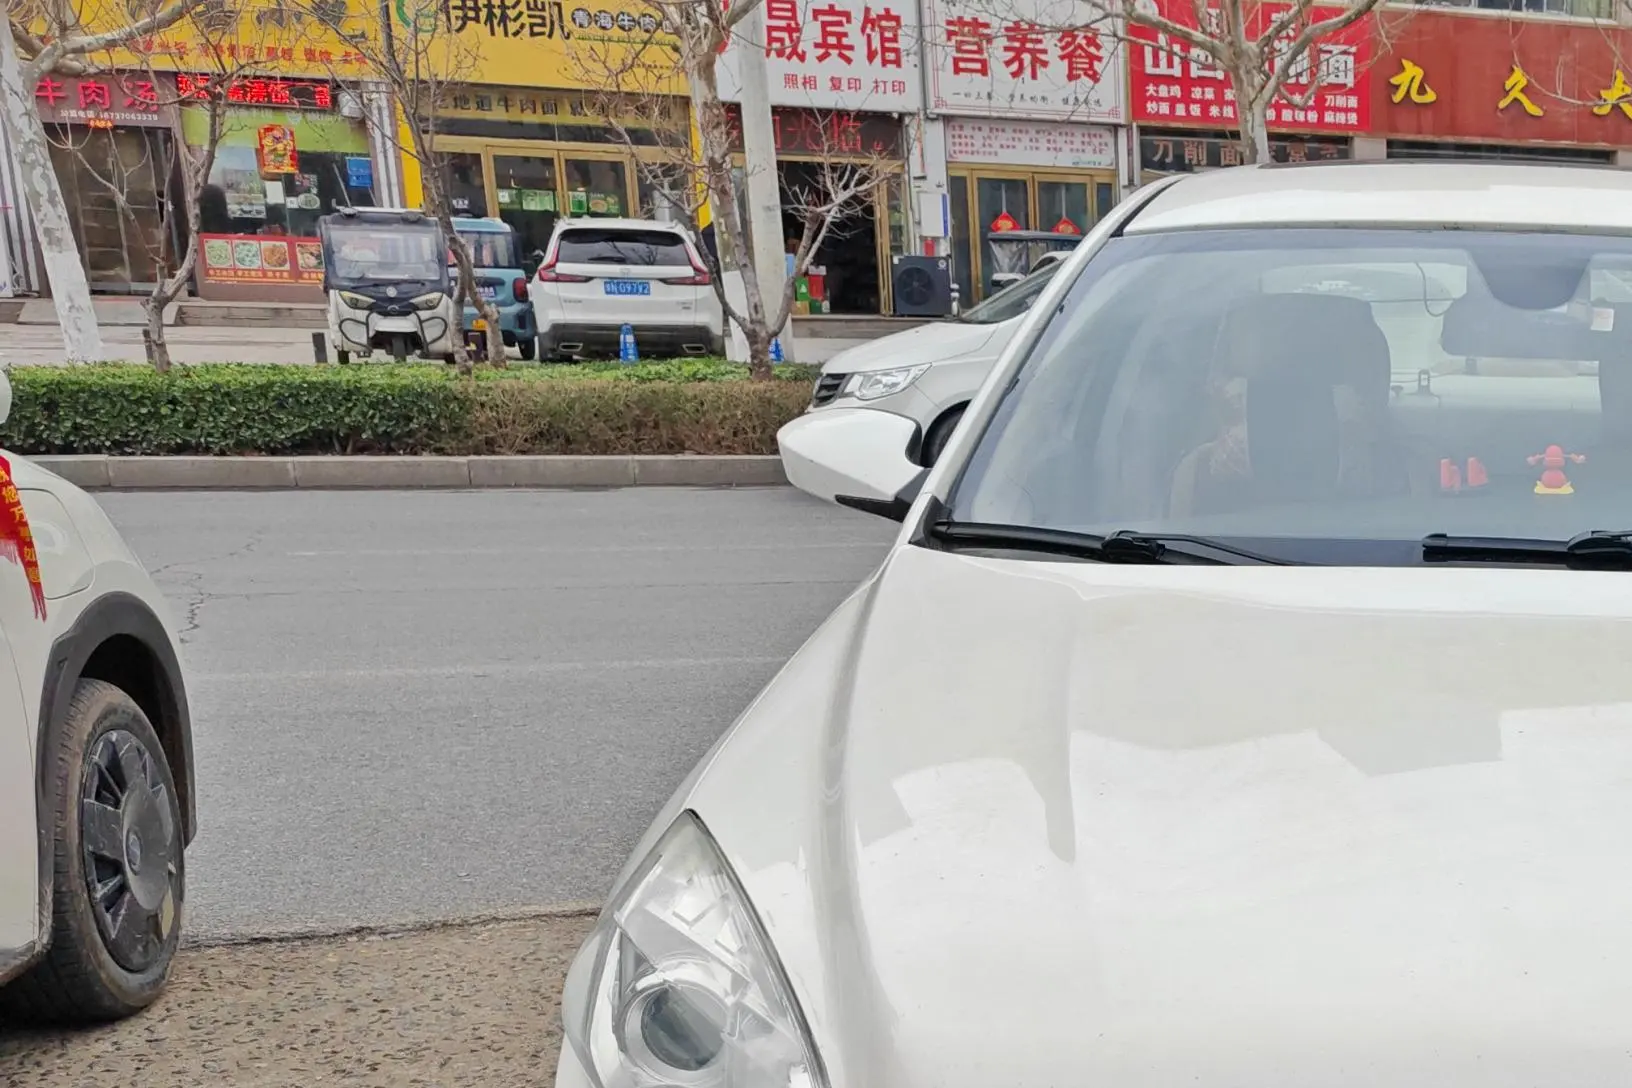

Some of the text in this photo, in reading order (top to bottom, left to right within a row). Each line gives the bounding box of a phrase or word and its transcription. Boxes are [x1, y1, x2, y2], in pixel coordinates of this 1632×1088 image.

[717, 0, 904, 69] 晟宾馆
[945, 16, 1104, 84] 营养餐
[784, 73, 906, 94] 照相 复印 打印
[1146, 84, 1182, 98] 大盘鸡
[1325, 95, 1358, 108] 刀削面
